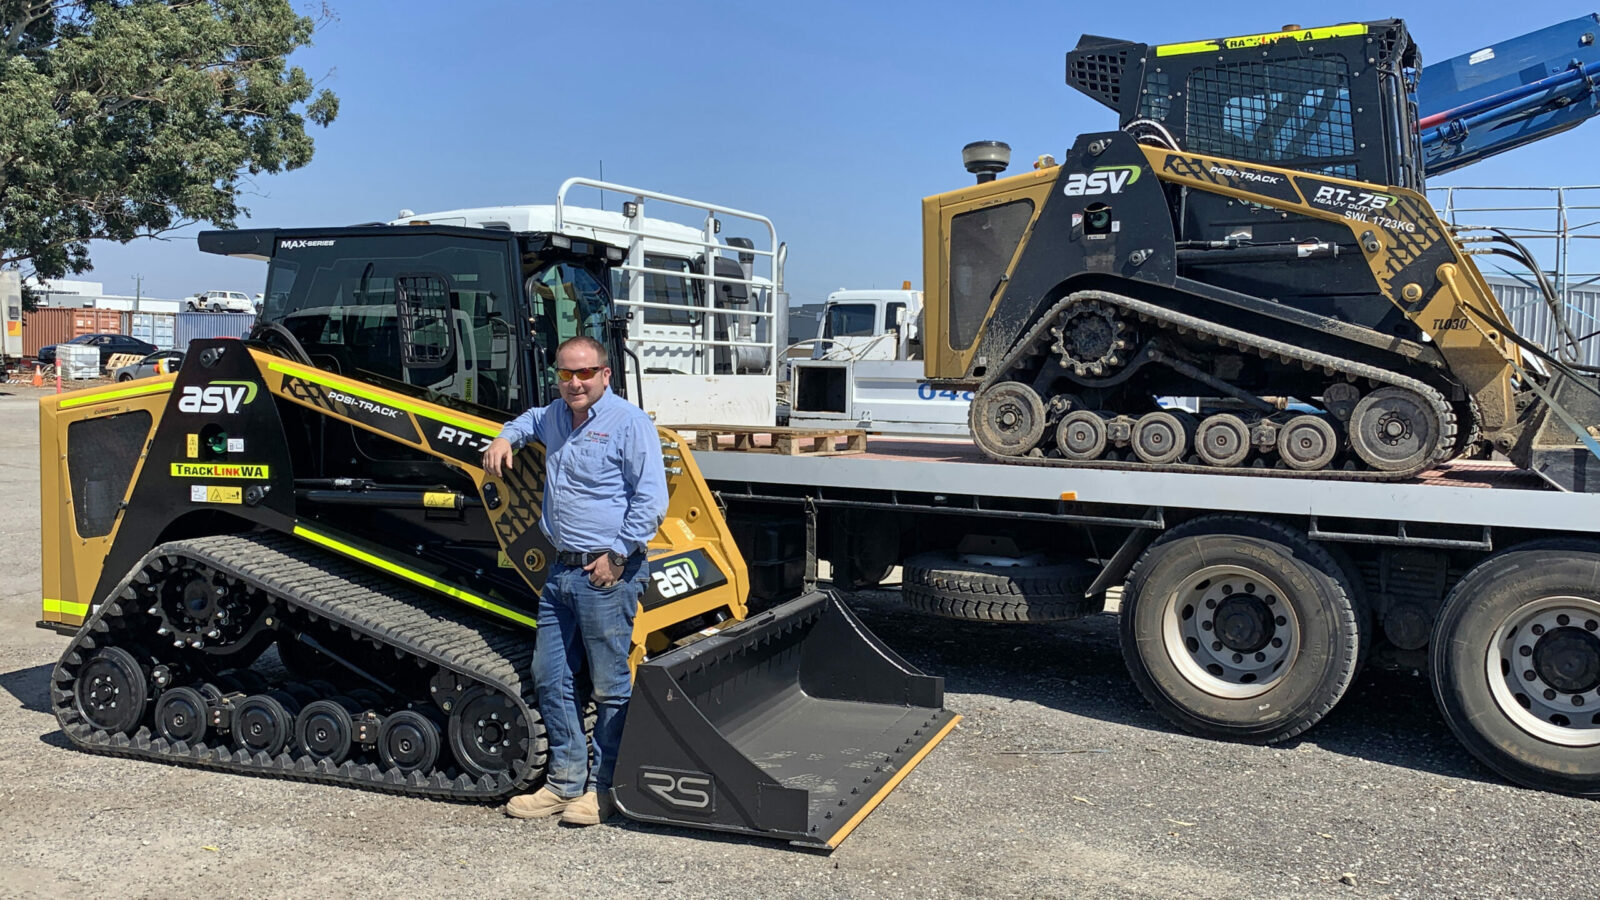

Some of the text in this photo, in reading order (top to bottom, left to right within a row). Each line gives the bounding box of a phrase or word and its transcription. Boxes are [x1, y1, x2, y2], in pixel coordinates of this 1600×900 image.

[1209, 166, 1280, 185] POSI-TRACK
[1313, 197, 1374, 213] HEAVY DUTY
[1316, 185, 1389, 209] RT-75
[1344, 210, 1416, 233] SWL 1723KG
[328, 391, 398, 419] POSI-TRACK
[643, 772, 710, 808] RS
